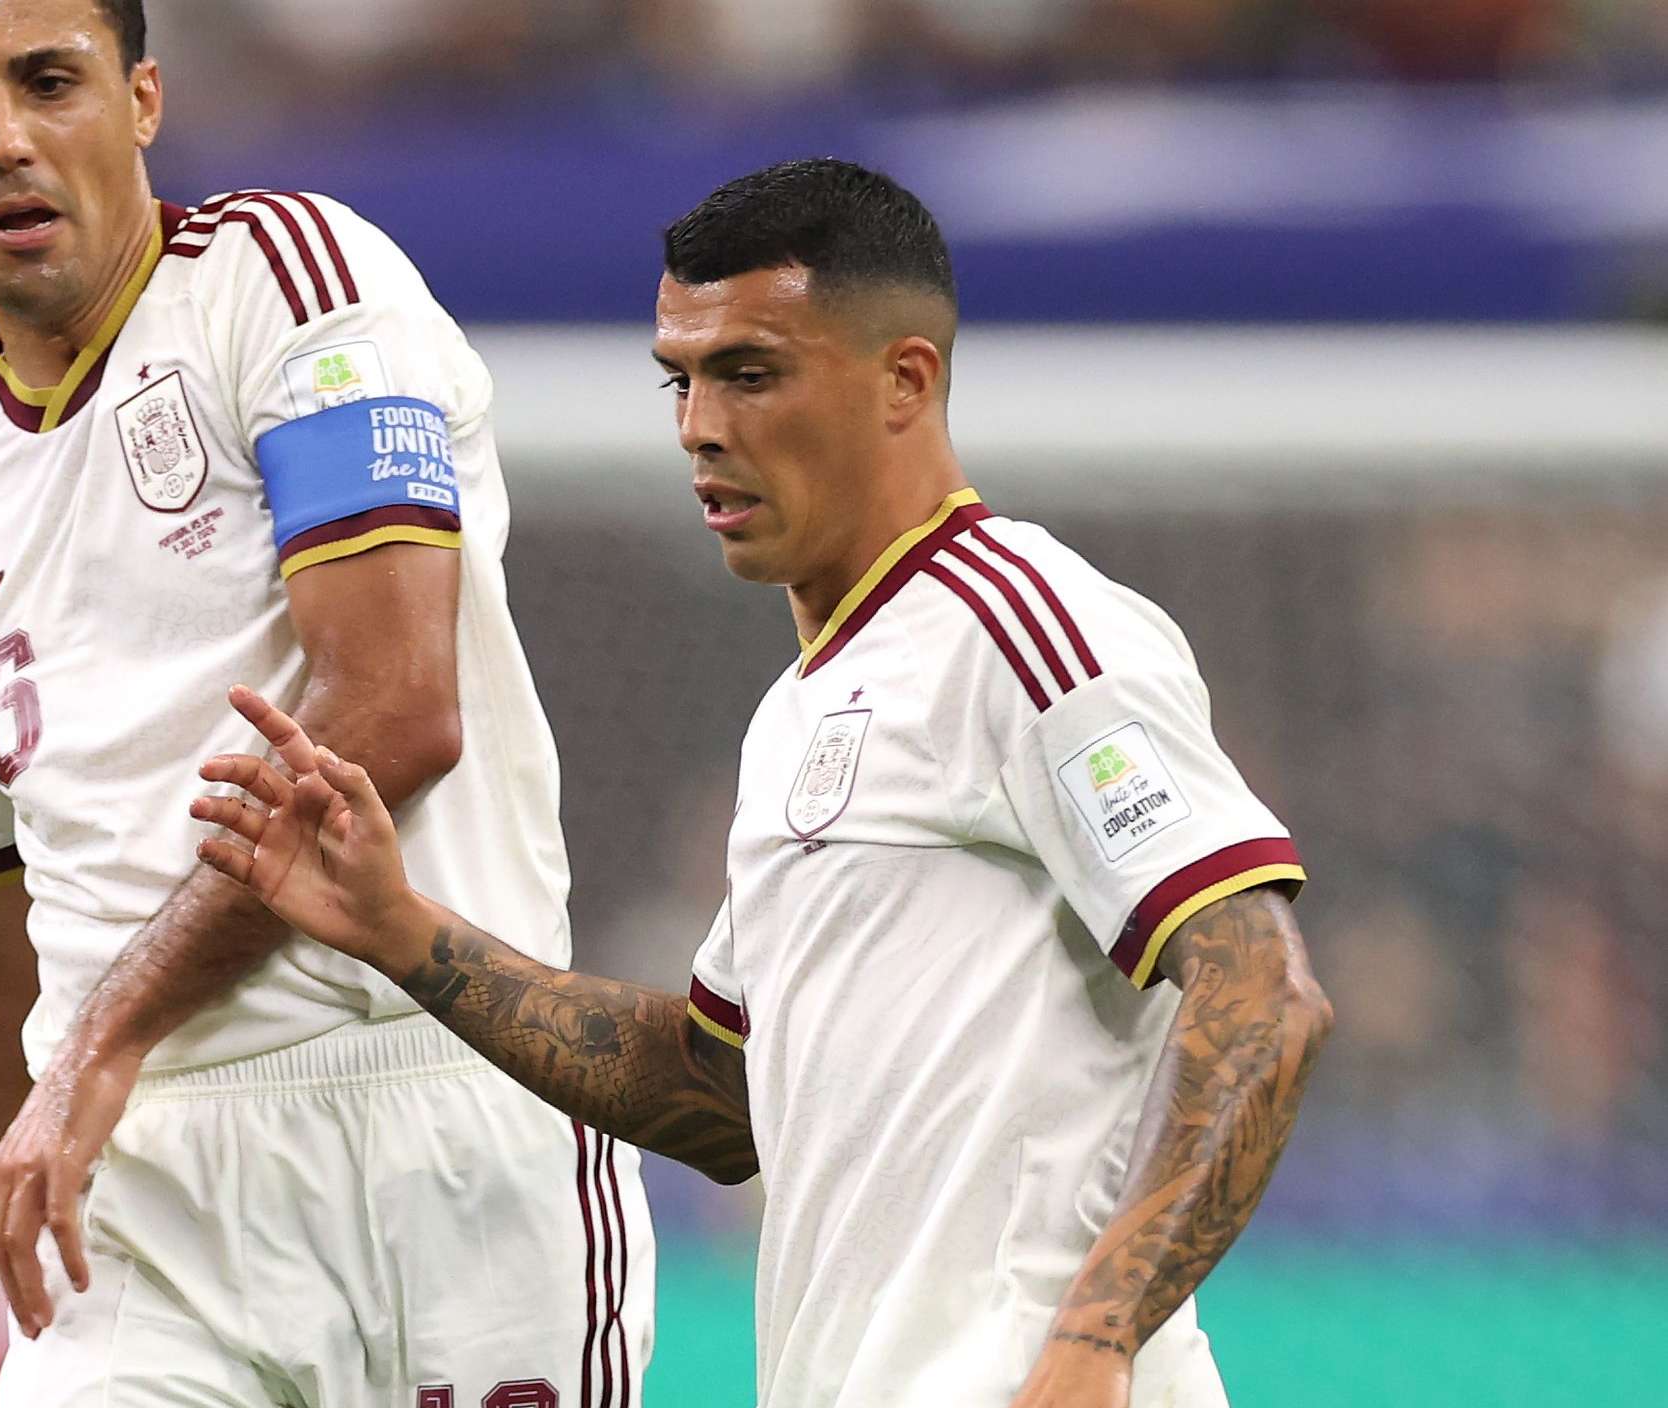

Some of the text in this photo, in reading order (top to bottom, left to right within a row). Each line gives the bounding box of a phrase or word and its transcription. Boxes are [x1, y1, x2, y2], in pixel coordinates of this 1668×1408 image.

[369, 406, 446, 436] FOOTBA
[372, 427, 455, 467] UNITE
[366, 454, 416, 481] the
[412, 485, 451, 502] FIFA
[1099, 774, 1150, 815] Unite For
[1103, 788, 1172, 838] EDUCATION
[1129, 817, 1157, 838] FIFA
